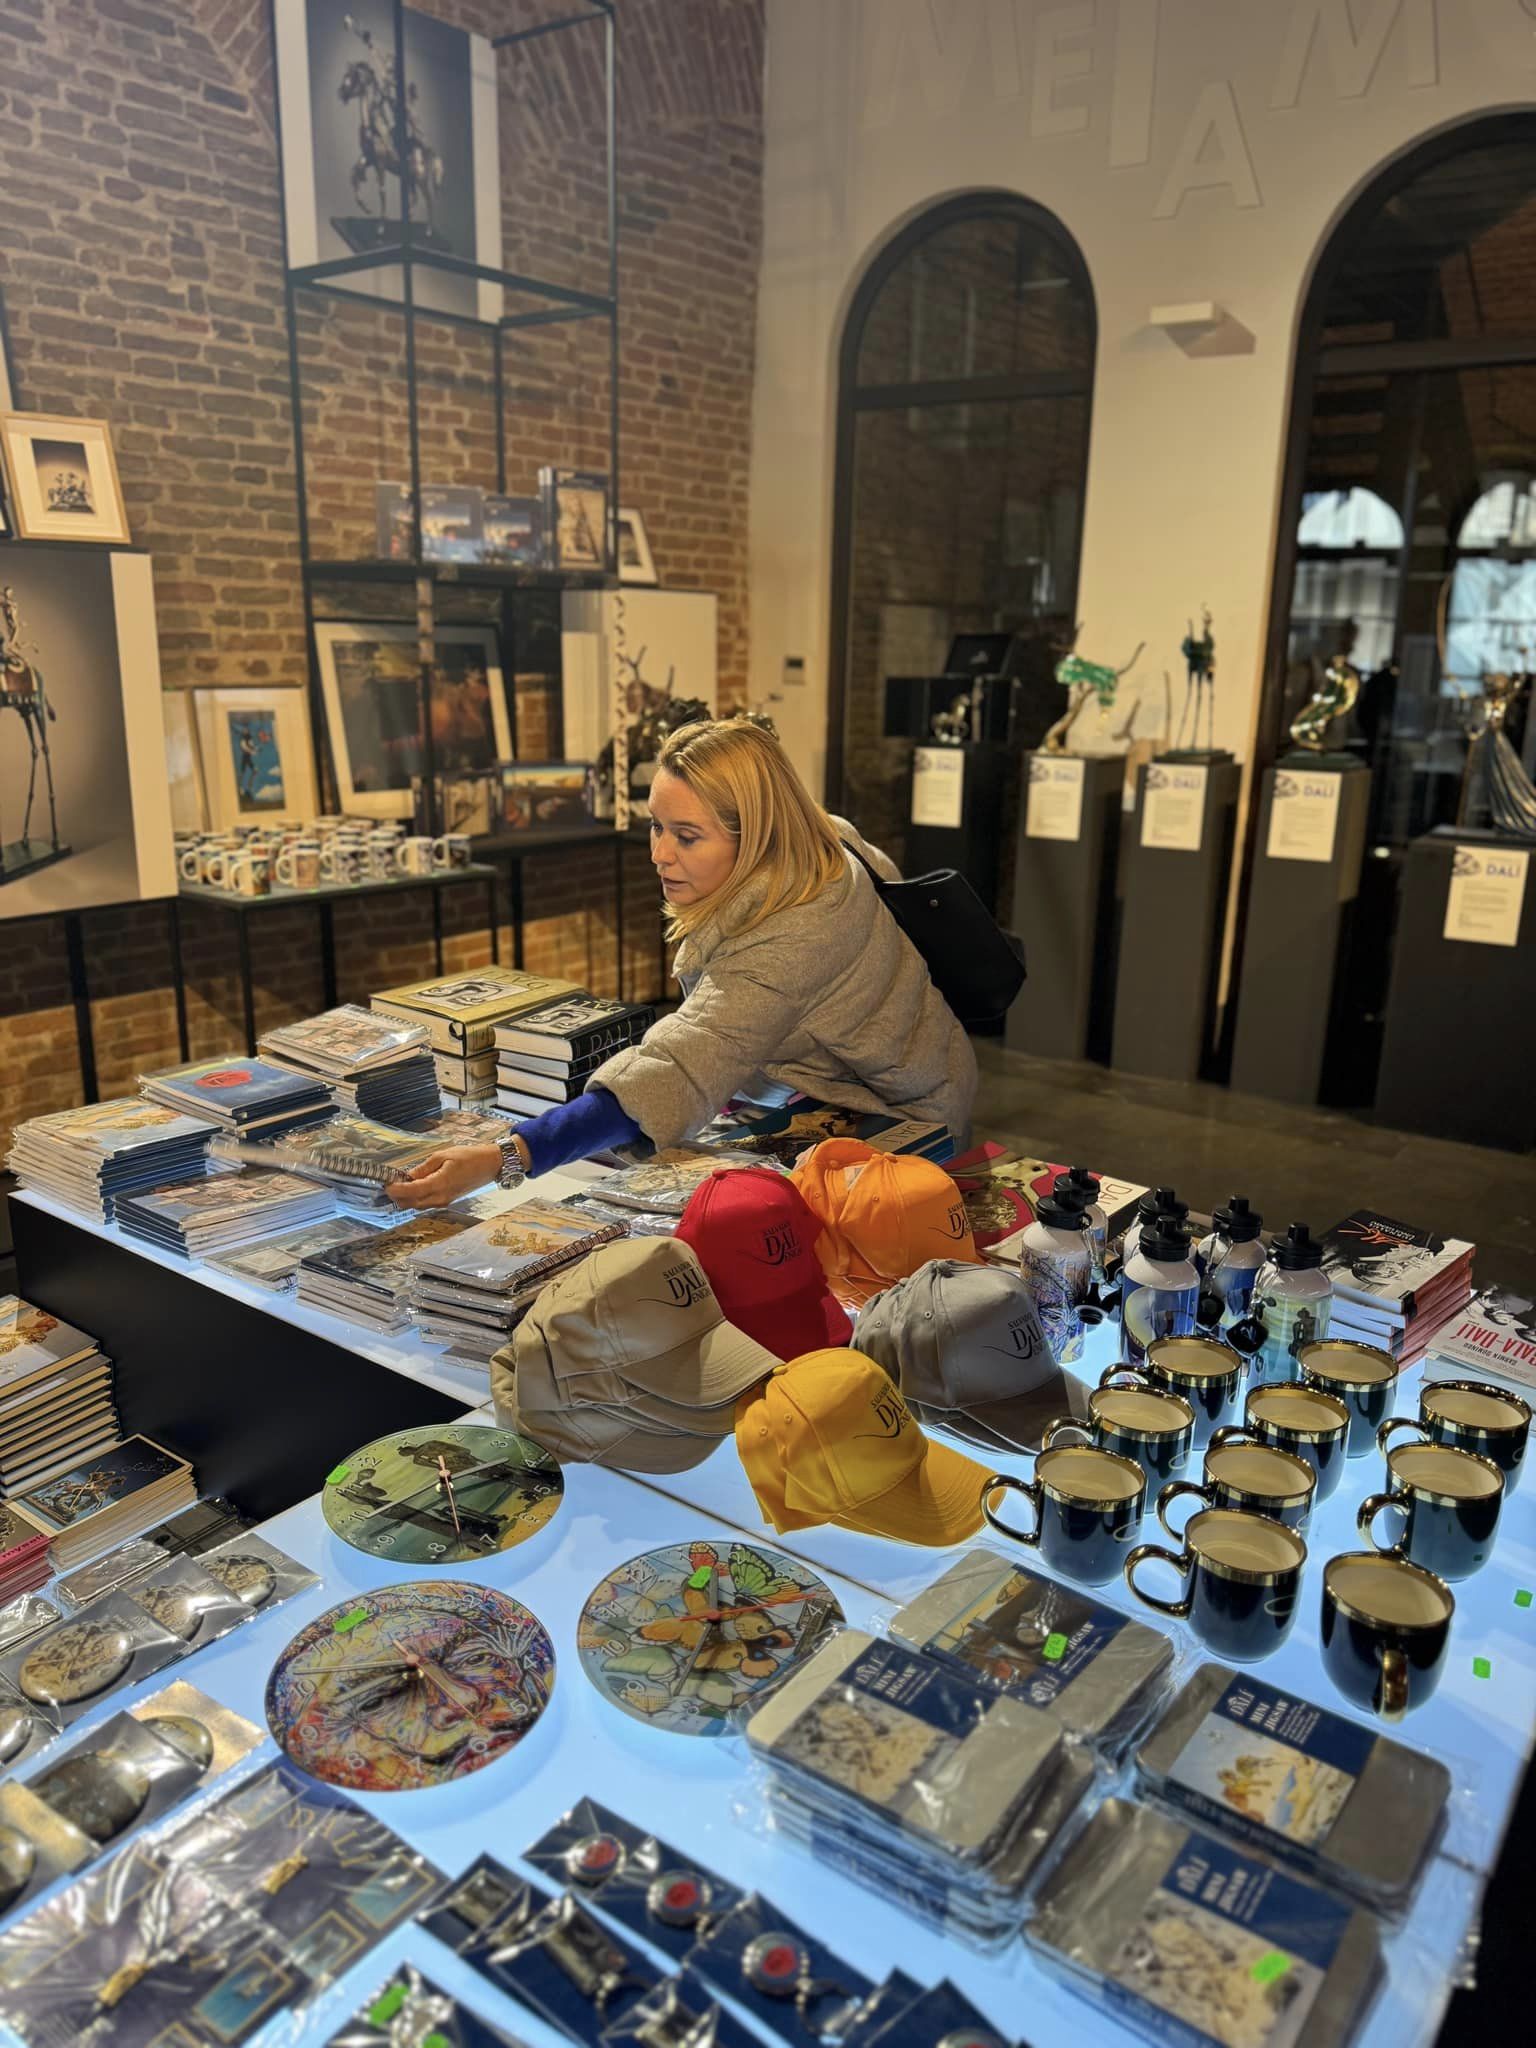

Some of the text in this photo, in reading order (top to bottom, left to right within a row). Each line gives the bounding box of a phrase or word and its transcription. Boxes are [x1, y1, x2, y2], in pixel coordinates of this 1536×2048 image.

[377, 1534, 396, 1545] 9
[428, 1543, 446, 1553] 8
[808, 1602, 823, 1618] 4
[601, 1640, 625, 1657] 10
[523, 1655, 537, 1670] 4
[872, 1669, 897, 1691] MINI
[885, 1662, 917, 1699] JIGSAW
[291, 1680, 317, 1699] 10
[509, 1699, 528, 1716] 5
[1250, 1701, 1270, 1724] MINI
[1264, 1699, 1289, 1731] JIGSAW
[299, 1725, 320, 1742] 9
[468, 1736, 488, 1753] 6
[347, 1753, 365, 1770] 8
